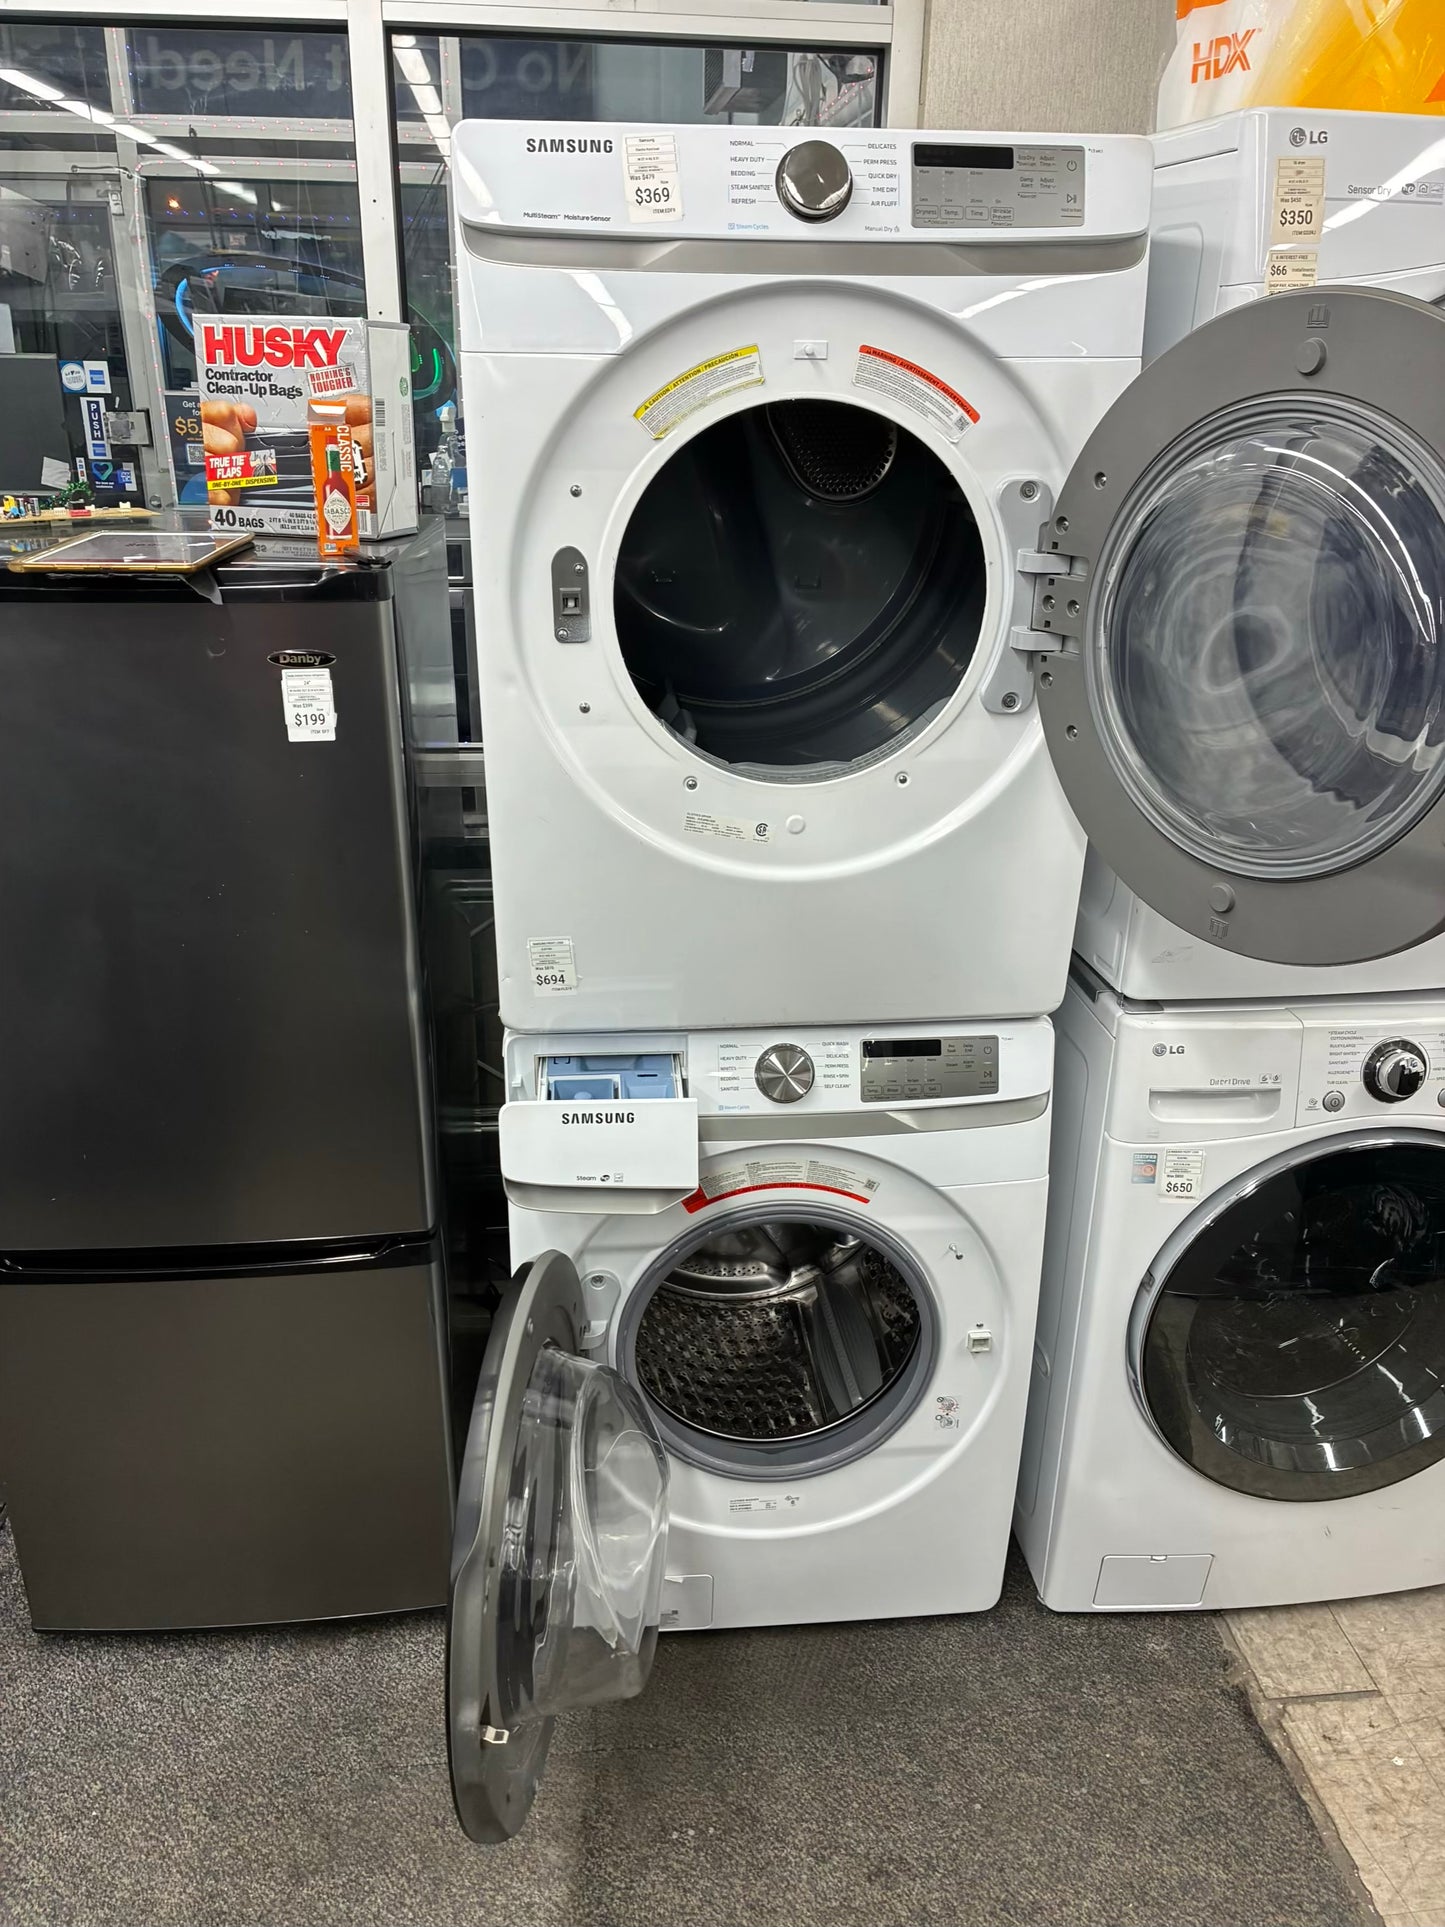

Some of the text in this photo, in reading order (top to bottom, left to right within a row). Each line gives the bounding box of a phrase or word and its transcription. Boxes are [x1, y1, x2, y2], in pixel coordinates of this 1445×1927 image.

[1191, 28, 1256, 84] HDX
[1309, 131, 1328, 144] LG
[526, 138, 613, 153] SAMSUNG
[635, 186, 670, 206] $369
[1347, 184, 1376, 194] Sensor
[1280, 209, 1313, 227] $350
[1270, 264, 1288, 276] $66
[203, 325, 348, 368] HUSKY
[871, 349, 898, 363] WARNING
[206, 368, 273, 382] Contractor
[309, 367, 351, 382] NOTHING'S
[207, 382, 303, 399] Clean-Up Bags
[648, 387, 671, 407] CAUTION
[672, 367, 702, 389] ATTENTION
[182, 400, 196, 408] Get
[90, 403, 102, 438] PUSH
[336, 425, 353, 472] CLASSIC
[210, 456, 231, 468] TRUE
[216, 467, 242, 479] FLAPS
[245, 476, 276, 485] DISPENSING
[214, 509, 236, 527] 40
[238, 517, 265, 529] BAGS
[279, 654, 321, 666] Danby
[294, 713, 326, 727] $199
[536, 974, 566, 986] $694
[1169, 1045, 1185, 1055] LG
[1232, 1078, 1251, 1086] Drive
[561, 1112, 635, 1124] SAMSUNG
[1165, 1181, 1193, 1193] $650
